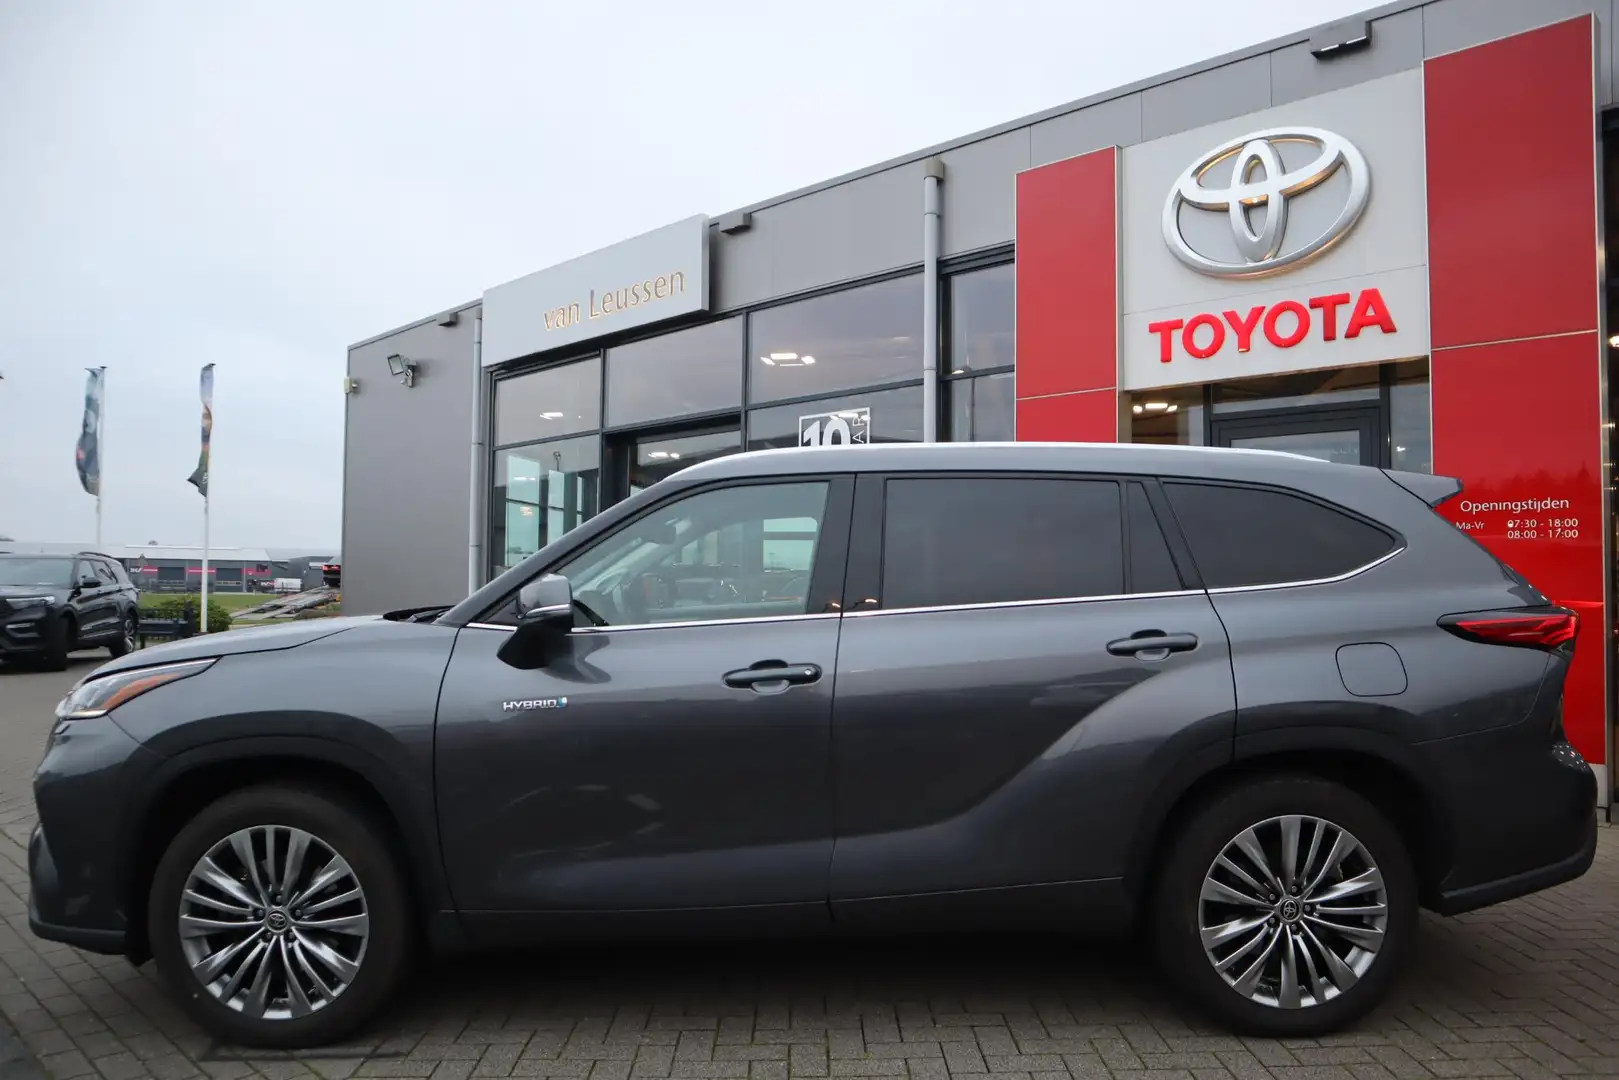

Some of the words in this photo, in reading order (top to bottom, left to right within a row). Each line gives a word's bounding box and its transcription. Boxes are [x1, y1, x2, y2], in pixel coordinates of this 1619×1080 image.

[543, 301, 581, 332] van
[588, 269, 685, 320] Leussen
[1148, 287, 1397, 363] TOYOTA
[1460, 497, 1570, 515] Openingstijden
[1455, 521, 1485, 531] Ma-Vr
[1507, 519, 1537, 529] 07:30
[1548, 518, 1579, 528] 18:00
[1507, 529, 1537, 540] 08:00
[1548, 528, 1579, 538] 17:00
[503, 700, 557, 710] HYBRID
